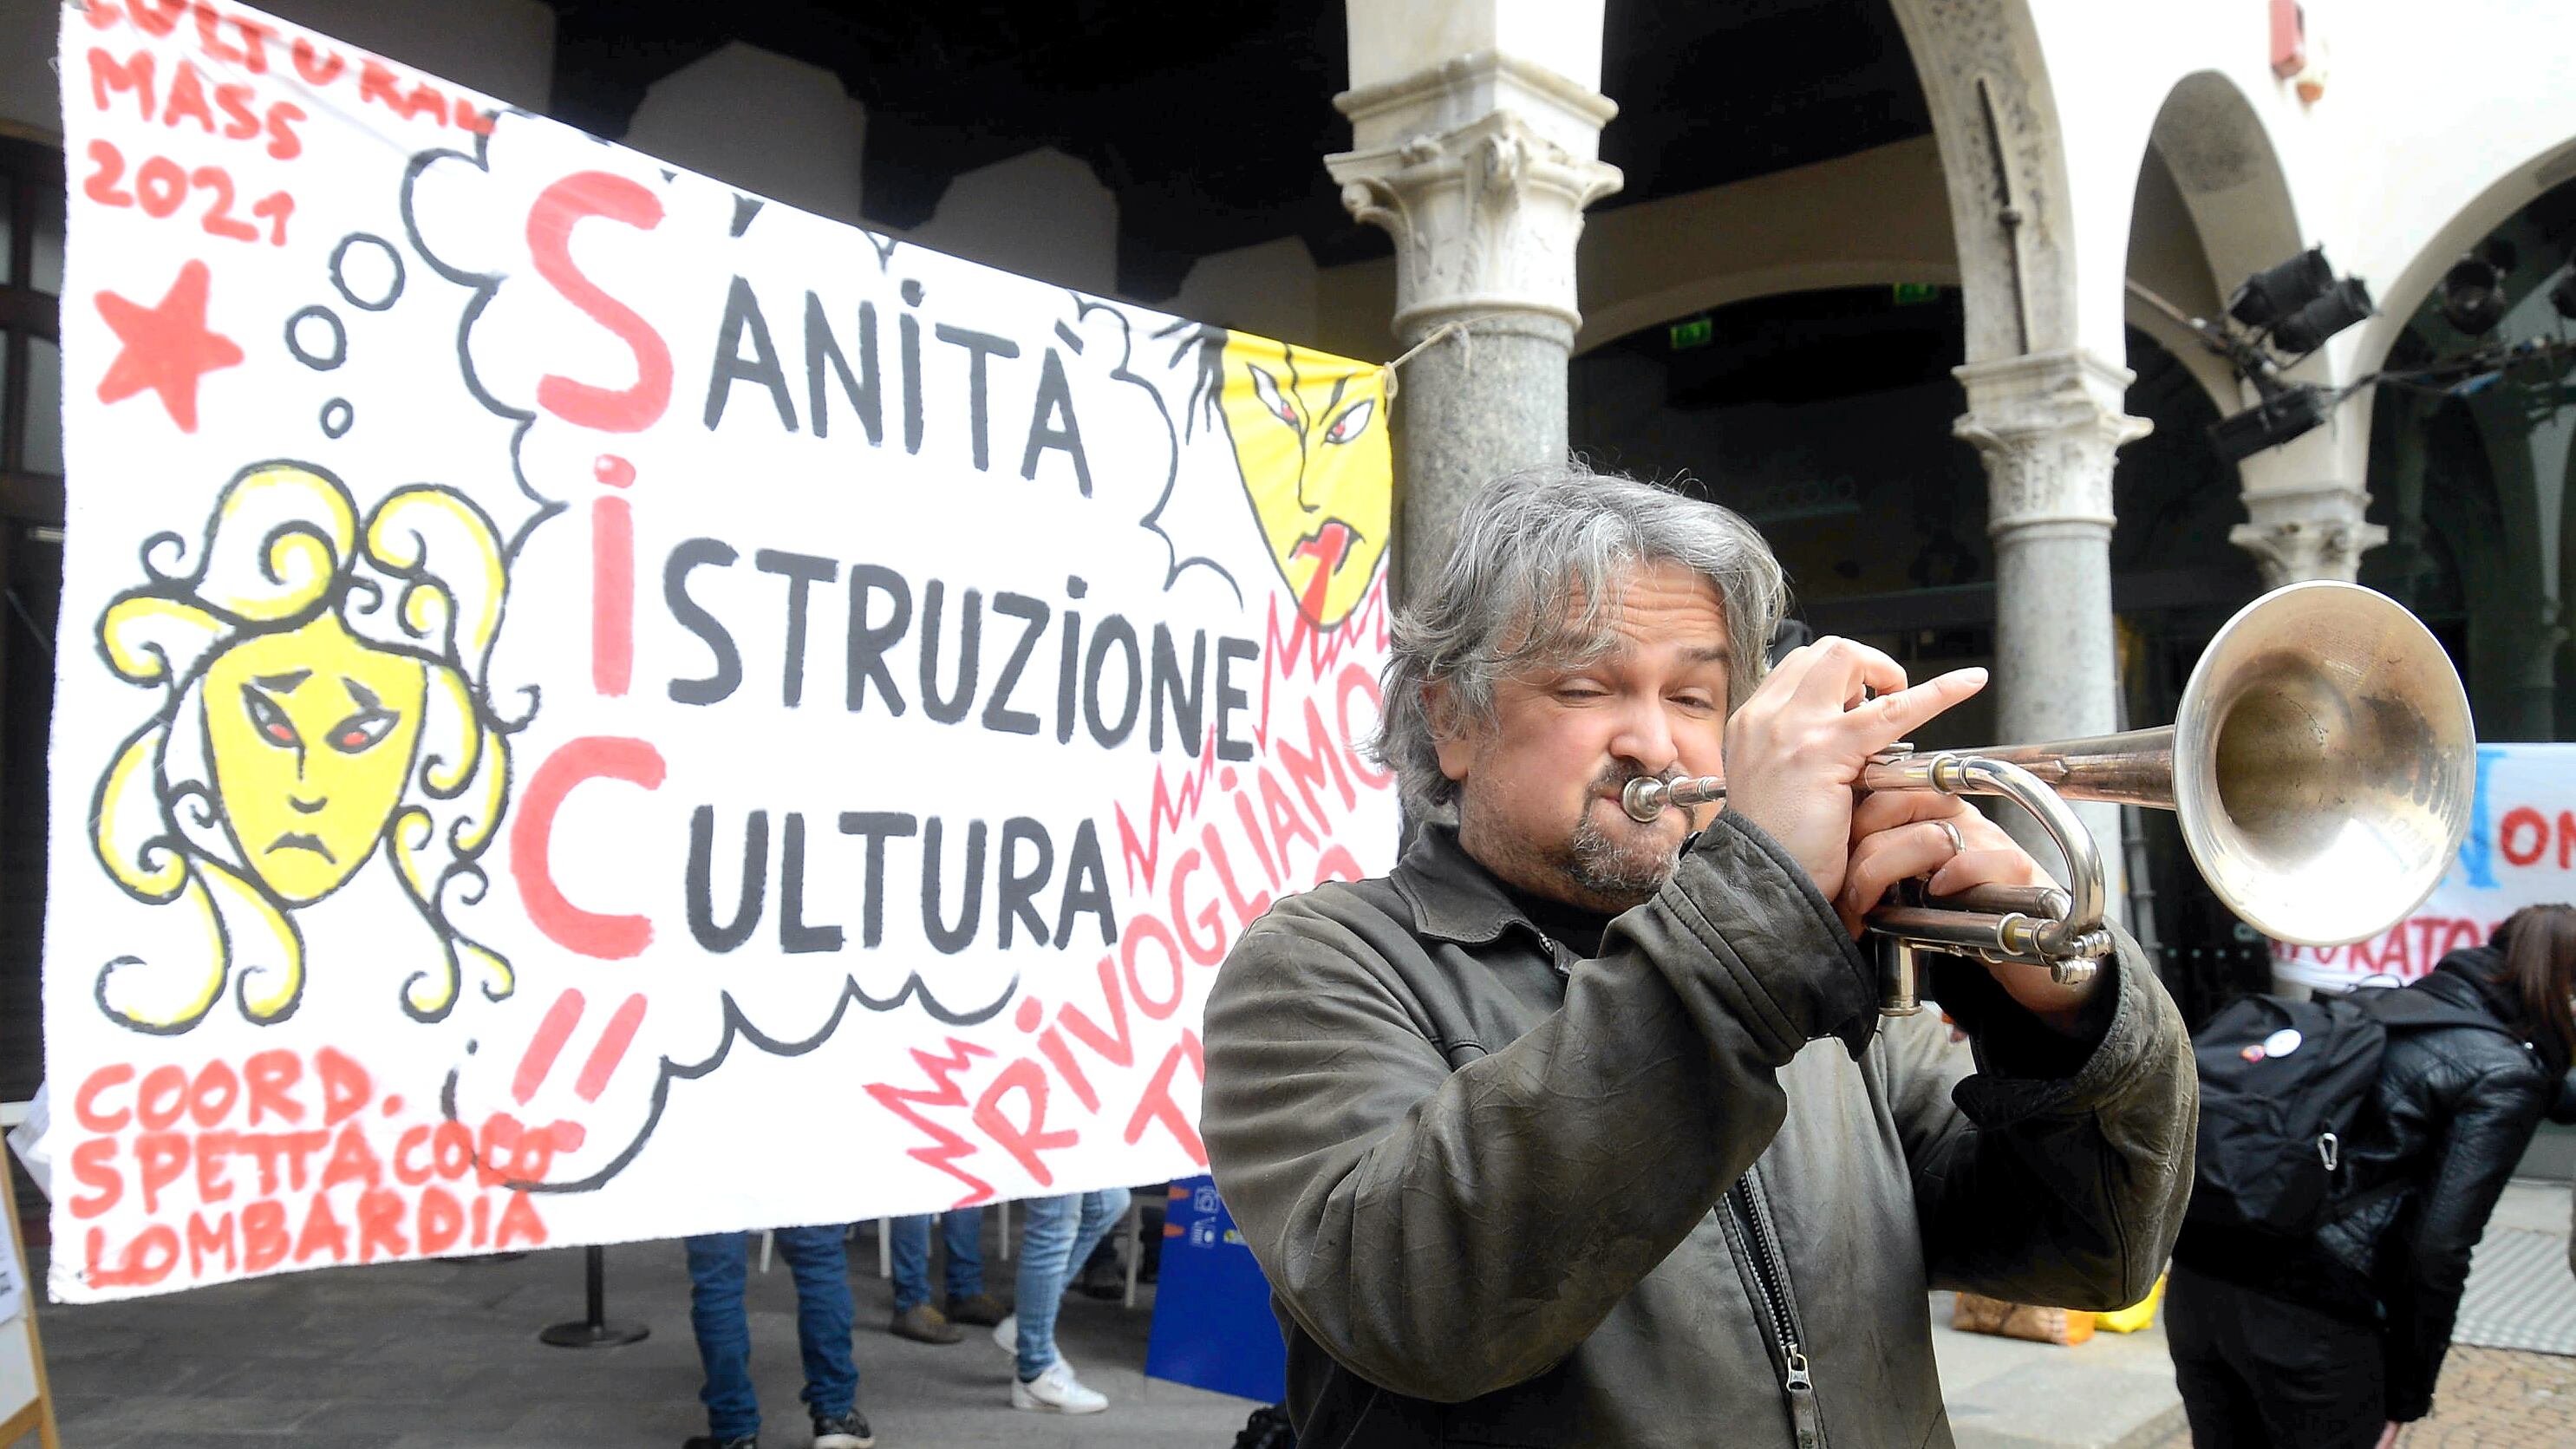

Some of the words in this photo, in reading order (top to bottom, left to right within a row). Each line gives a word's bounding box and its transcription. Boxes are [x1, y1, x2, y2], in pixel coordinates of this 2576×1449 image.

[87, 47, 308, 161] MASS
[84, 139, 296, 247] 2021
[75, 1046, 405, 1133] COORD.
[85, 1186, 549, 1290] LOMBARDIA
